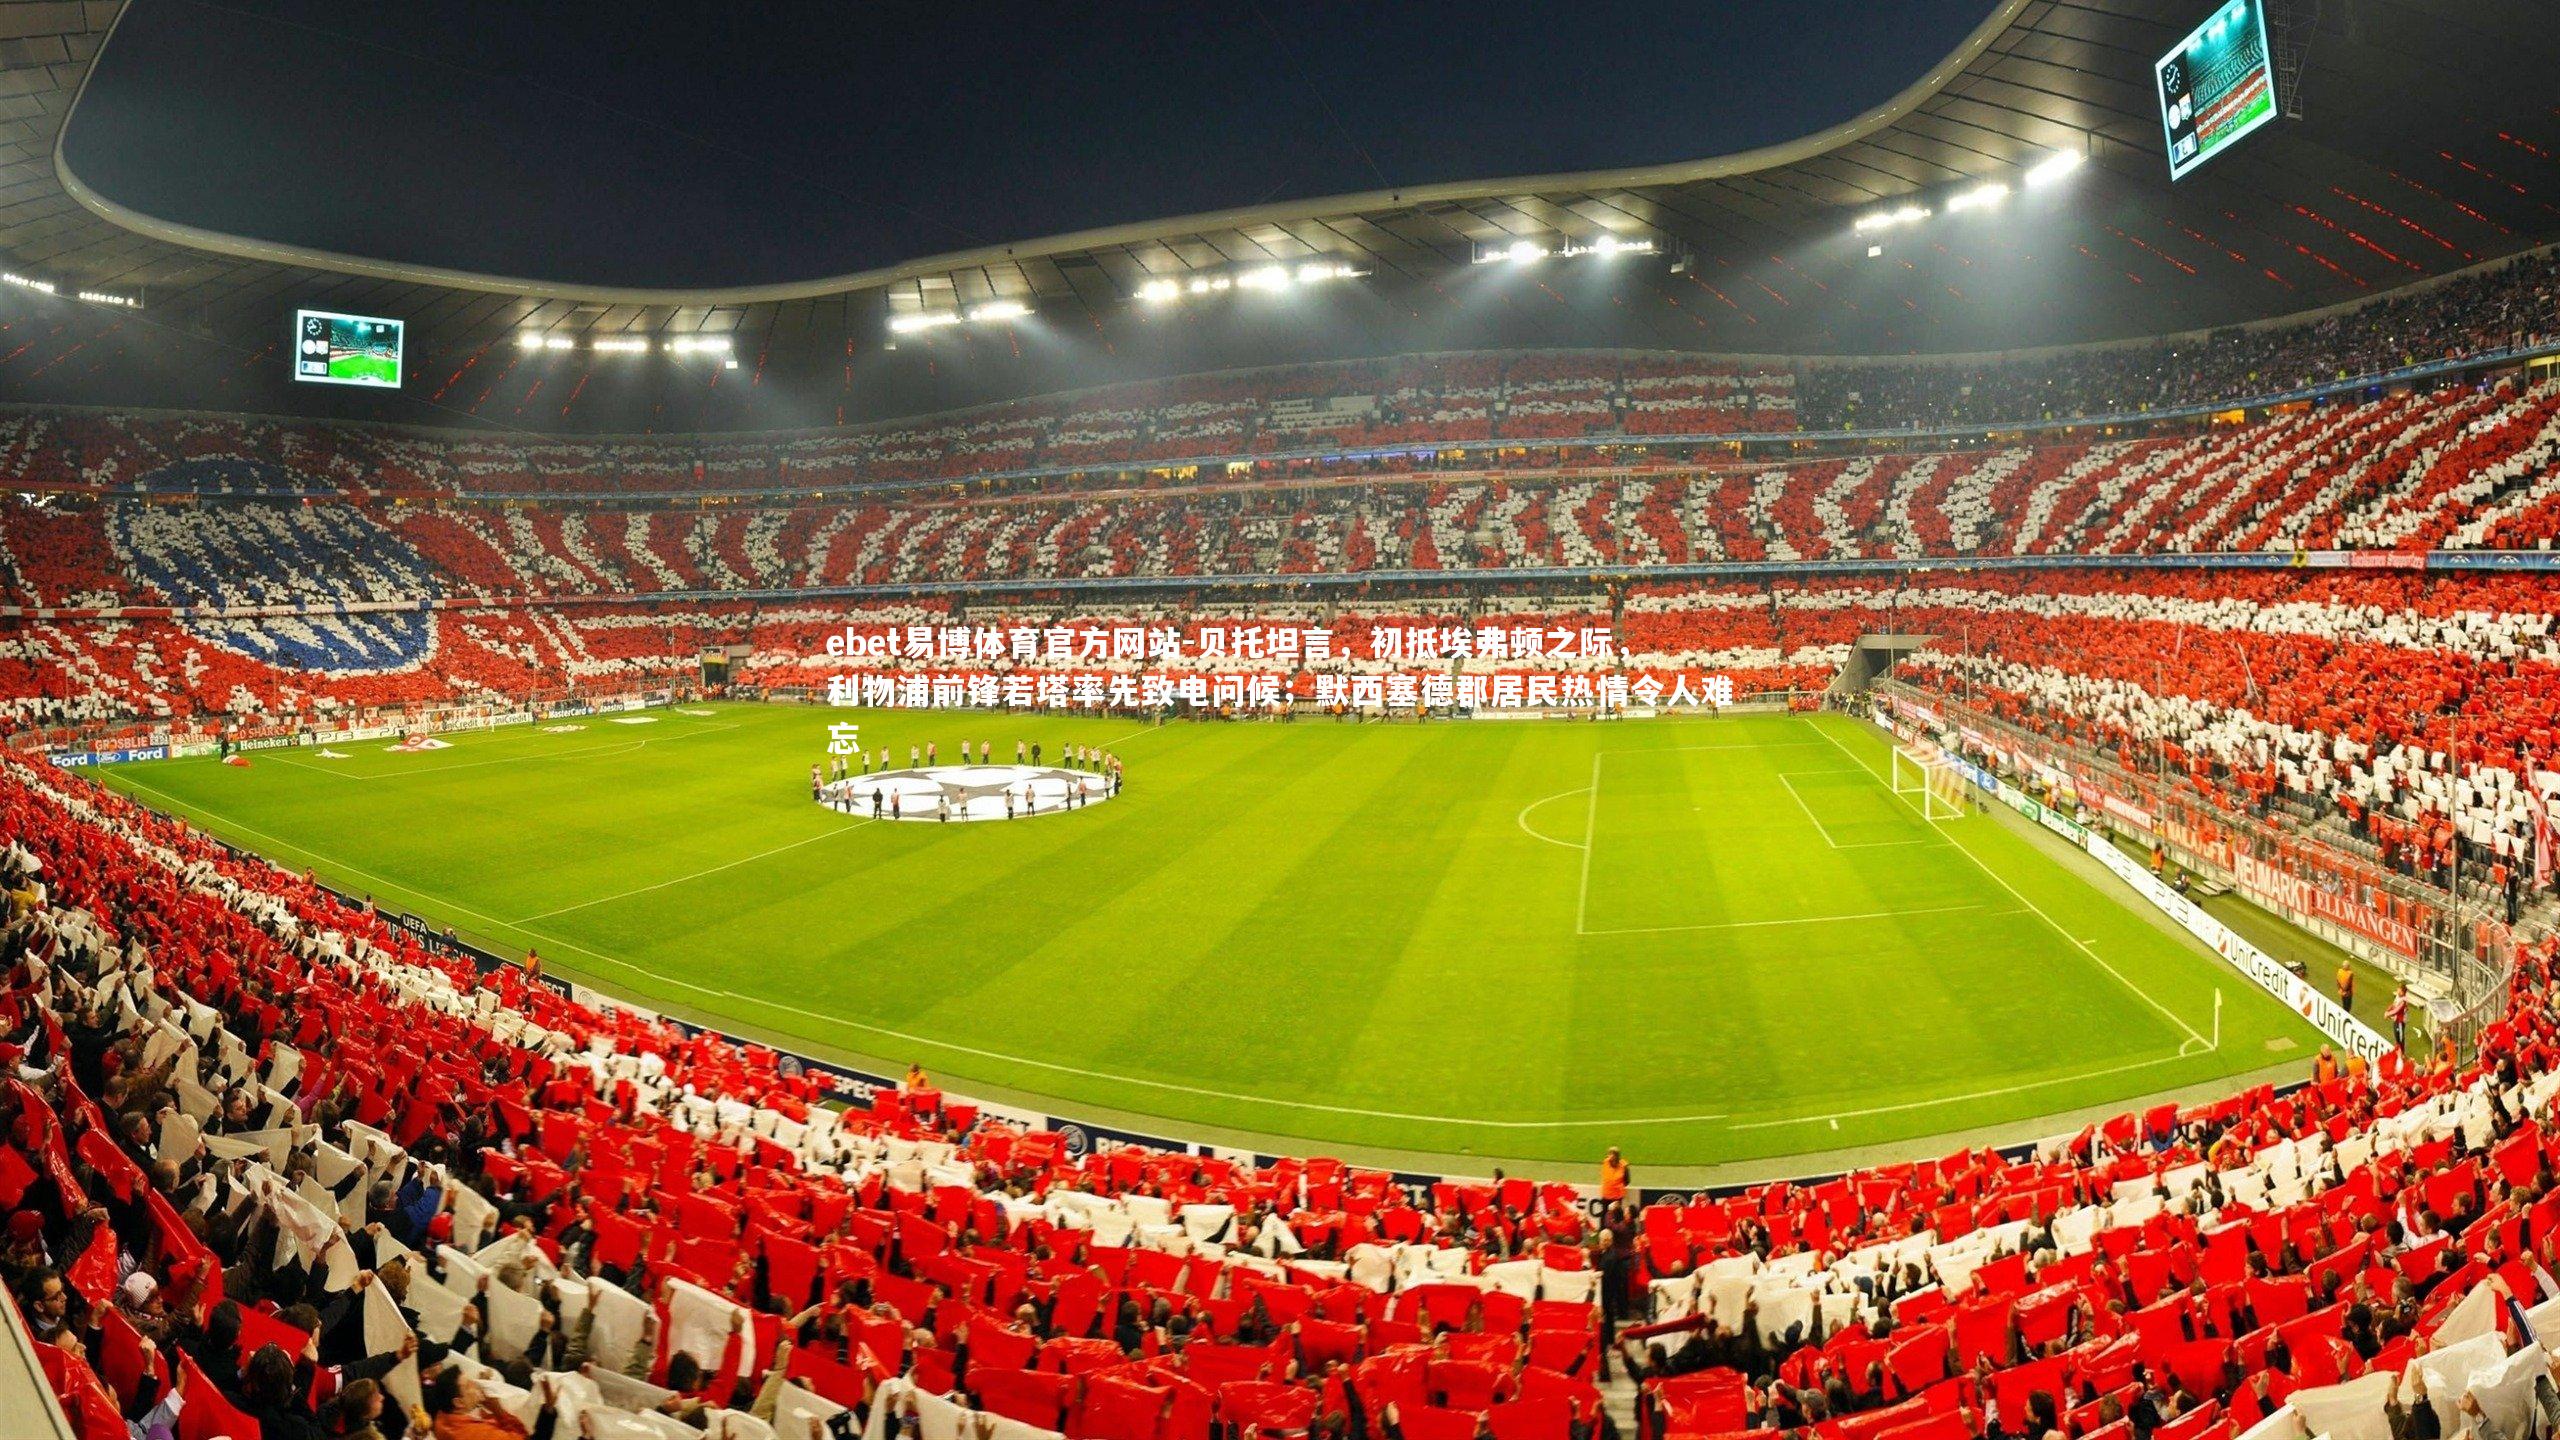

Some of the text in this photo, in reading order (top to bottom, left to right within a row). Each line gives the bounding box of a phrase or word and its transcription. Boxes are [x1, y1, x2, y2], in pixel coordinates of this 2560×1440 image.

[128, 748, 163, 761] Ford
[240, 738, 289, 751] Heineken
[51, 754, 88, 767] Ford
[2234, 851, 2311, 915] NEUMARKT
[403, 915, 427, 935] UEFA
[2316, 889, 2414, 952] ELLWANGEN
[2230, 936, 2289, 1000] UniCredit
